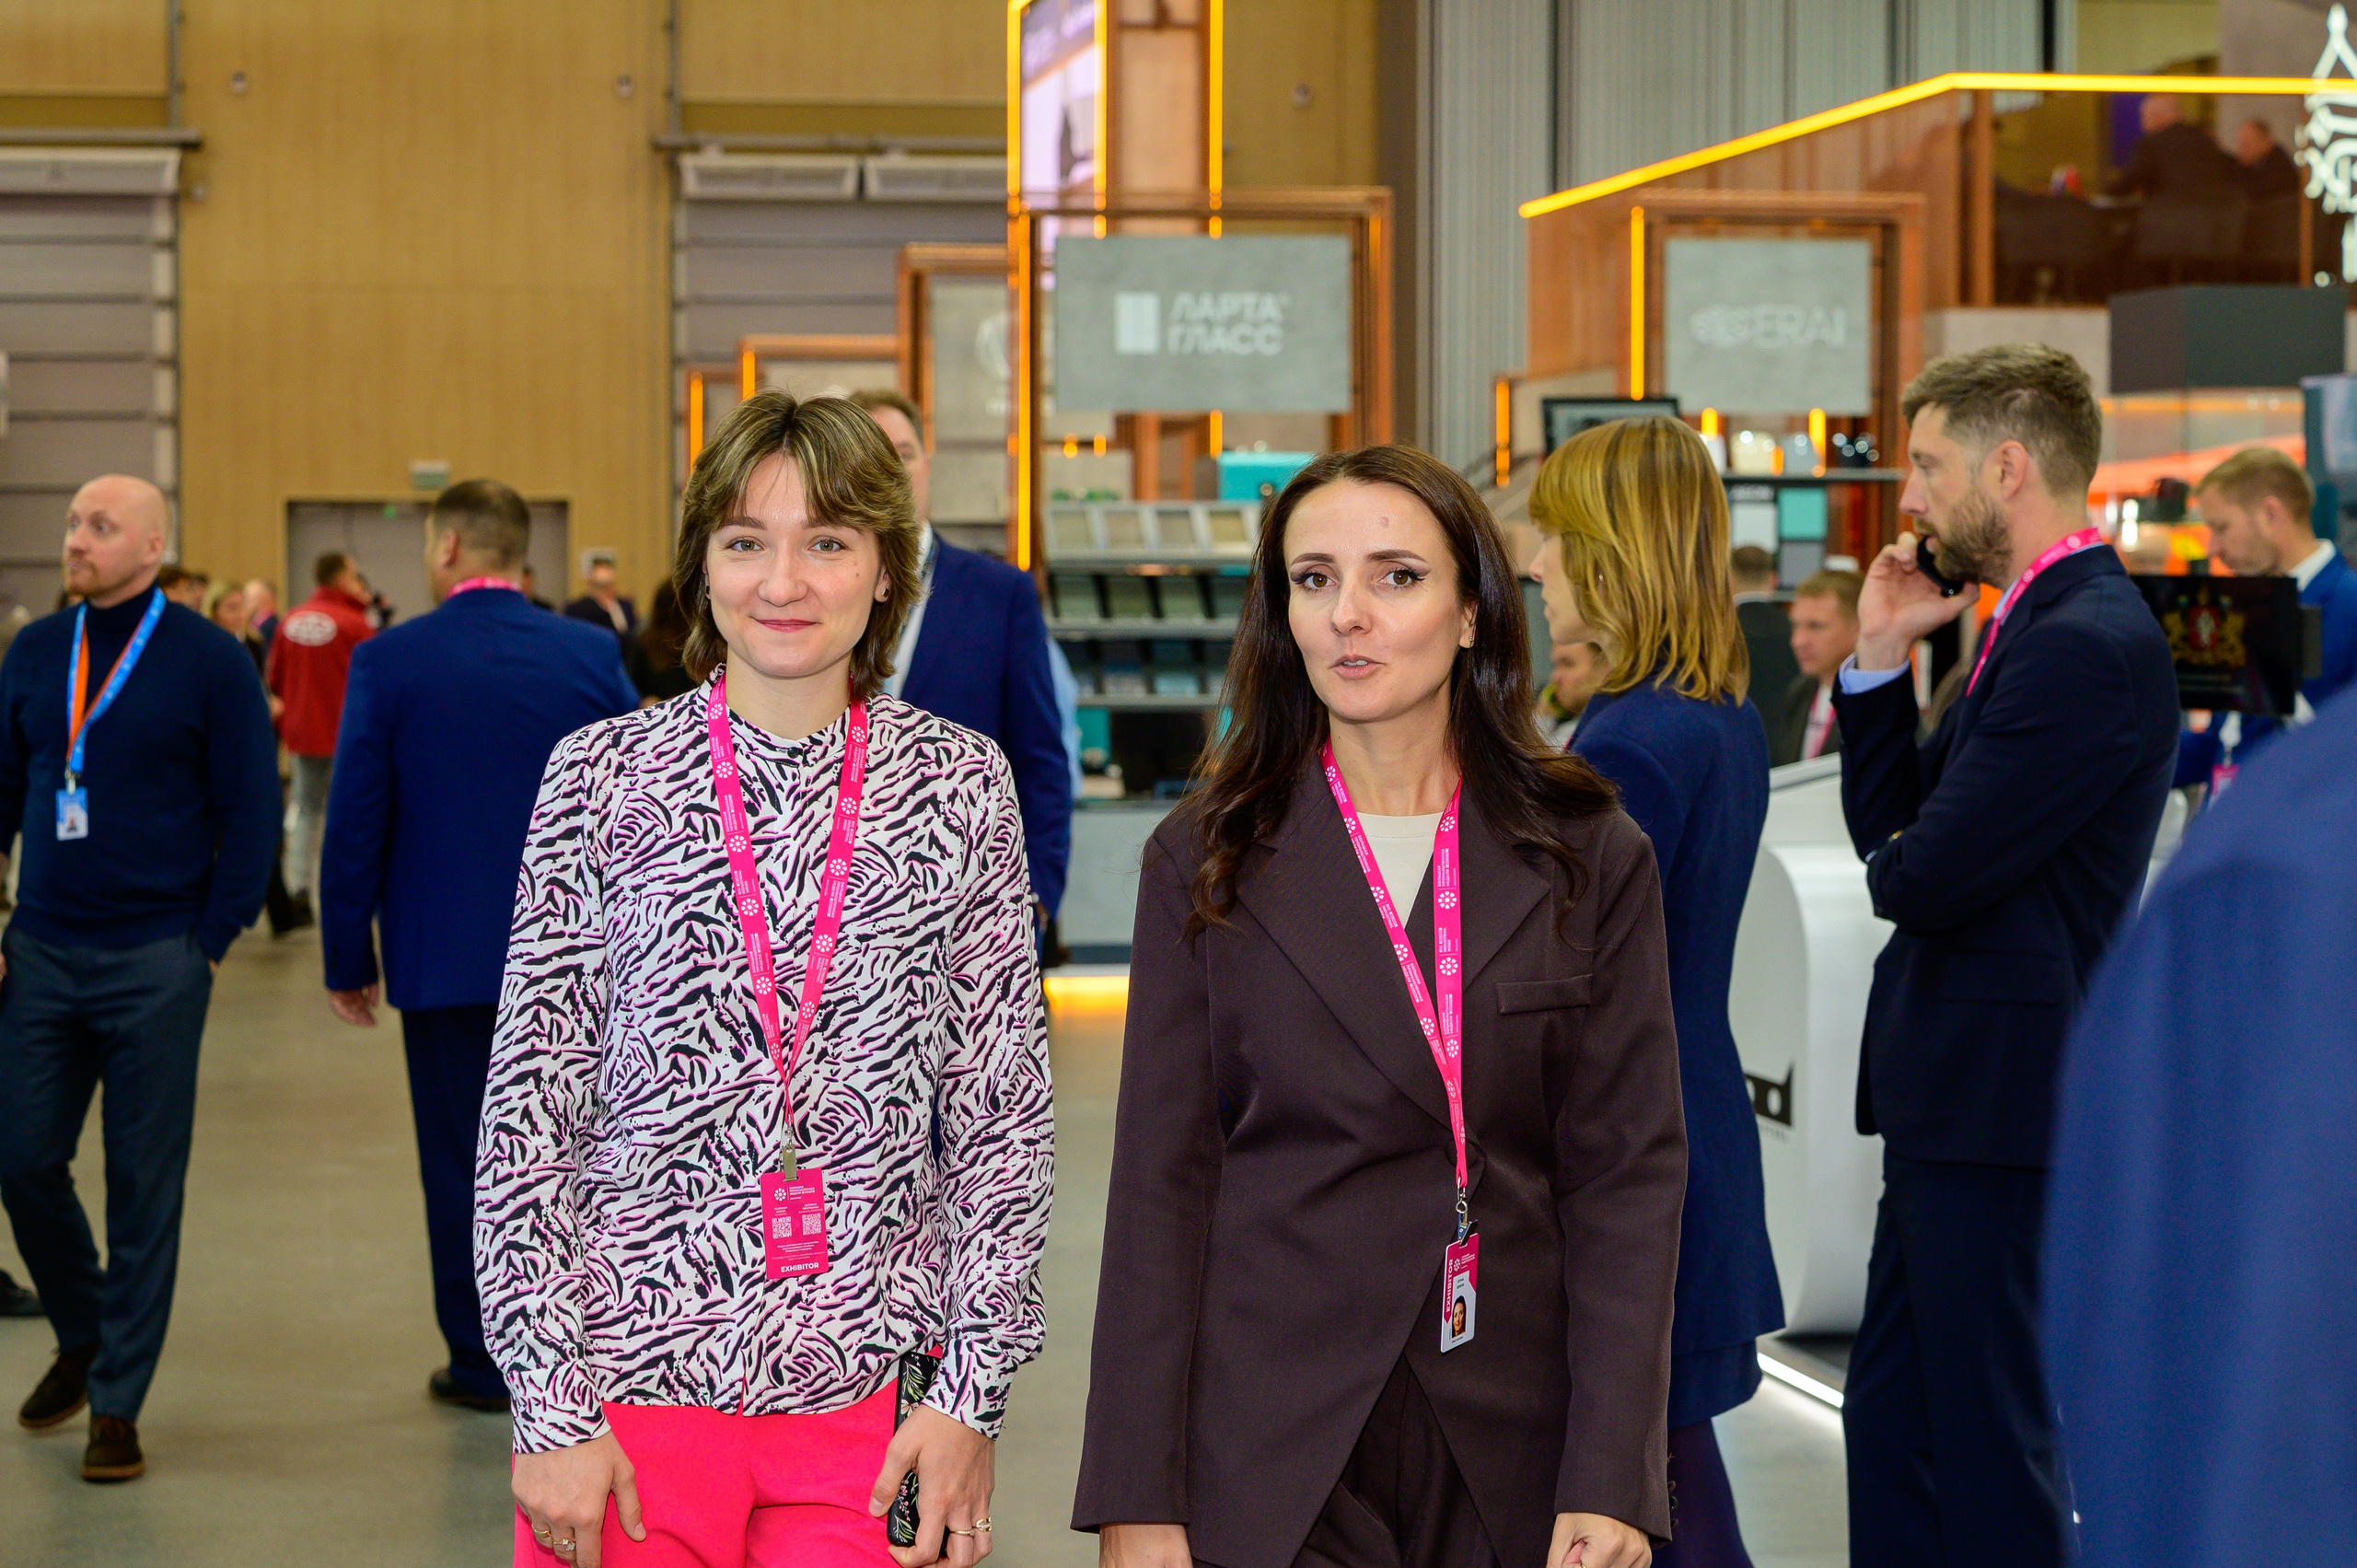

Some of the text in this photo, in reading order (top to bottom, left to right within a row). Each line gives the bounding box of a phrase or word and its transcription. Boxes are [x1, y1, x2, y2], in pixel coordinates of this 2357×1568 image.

[1169, 292, 1283, 322] ЛАРТА
[1167, 325, 1284, 354] ГЛАСС
[781, 1262, 819, 1272] EXHIBITOR
